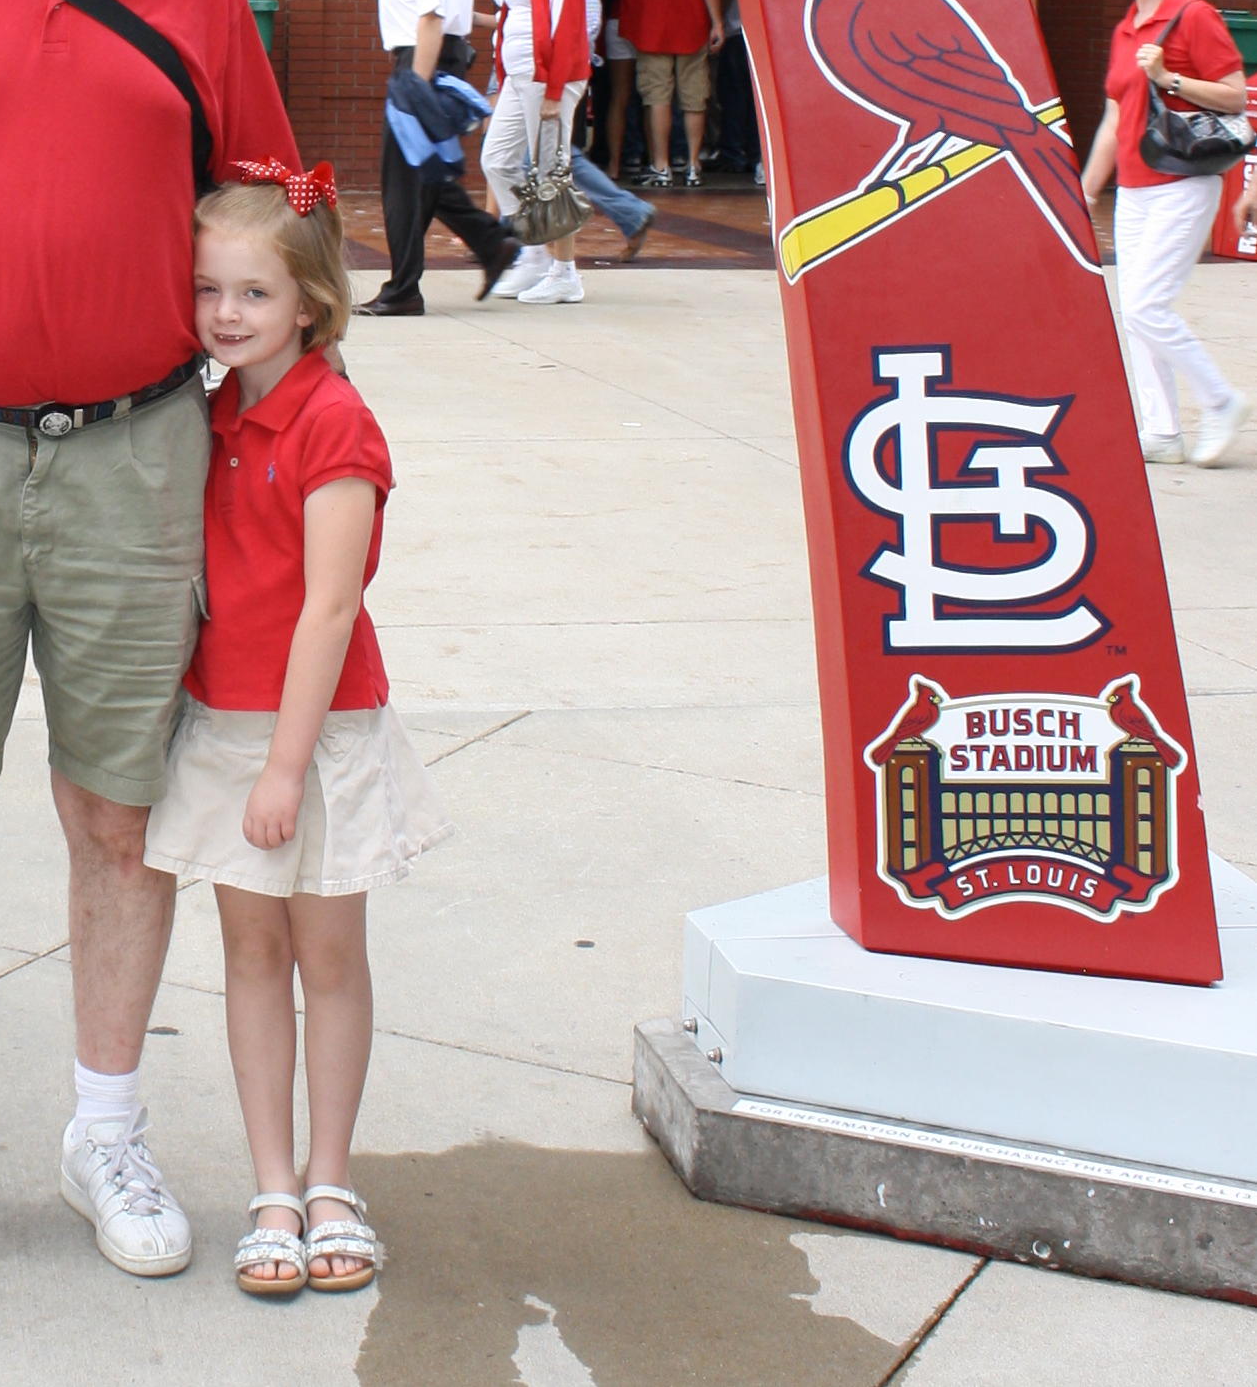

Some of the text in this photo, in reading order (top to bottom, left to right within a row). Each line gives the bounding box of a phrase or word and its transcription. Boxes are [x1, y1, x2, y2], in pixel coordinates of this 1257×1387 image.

[964, 708, 1083, 741] BUSCH
[948, 744, 1100, 774] STADIUM
[956, 864, 1099, 900] ST. LOUIS
[748, 1104, 783, 1116] FOR
[787, 1111, 912, 1139] INFORMATION
[916, 1134, 943, 1145] ON
[948, 1139, 1067, 1167] PURCHASING
[1072, 1162, 1113, 1176] THIS
[1182, 1181, 1224, 1195] CALL
